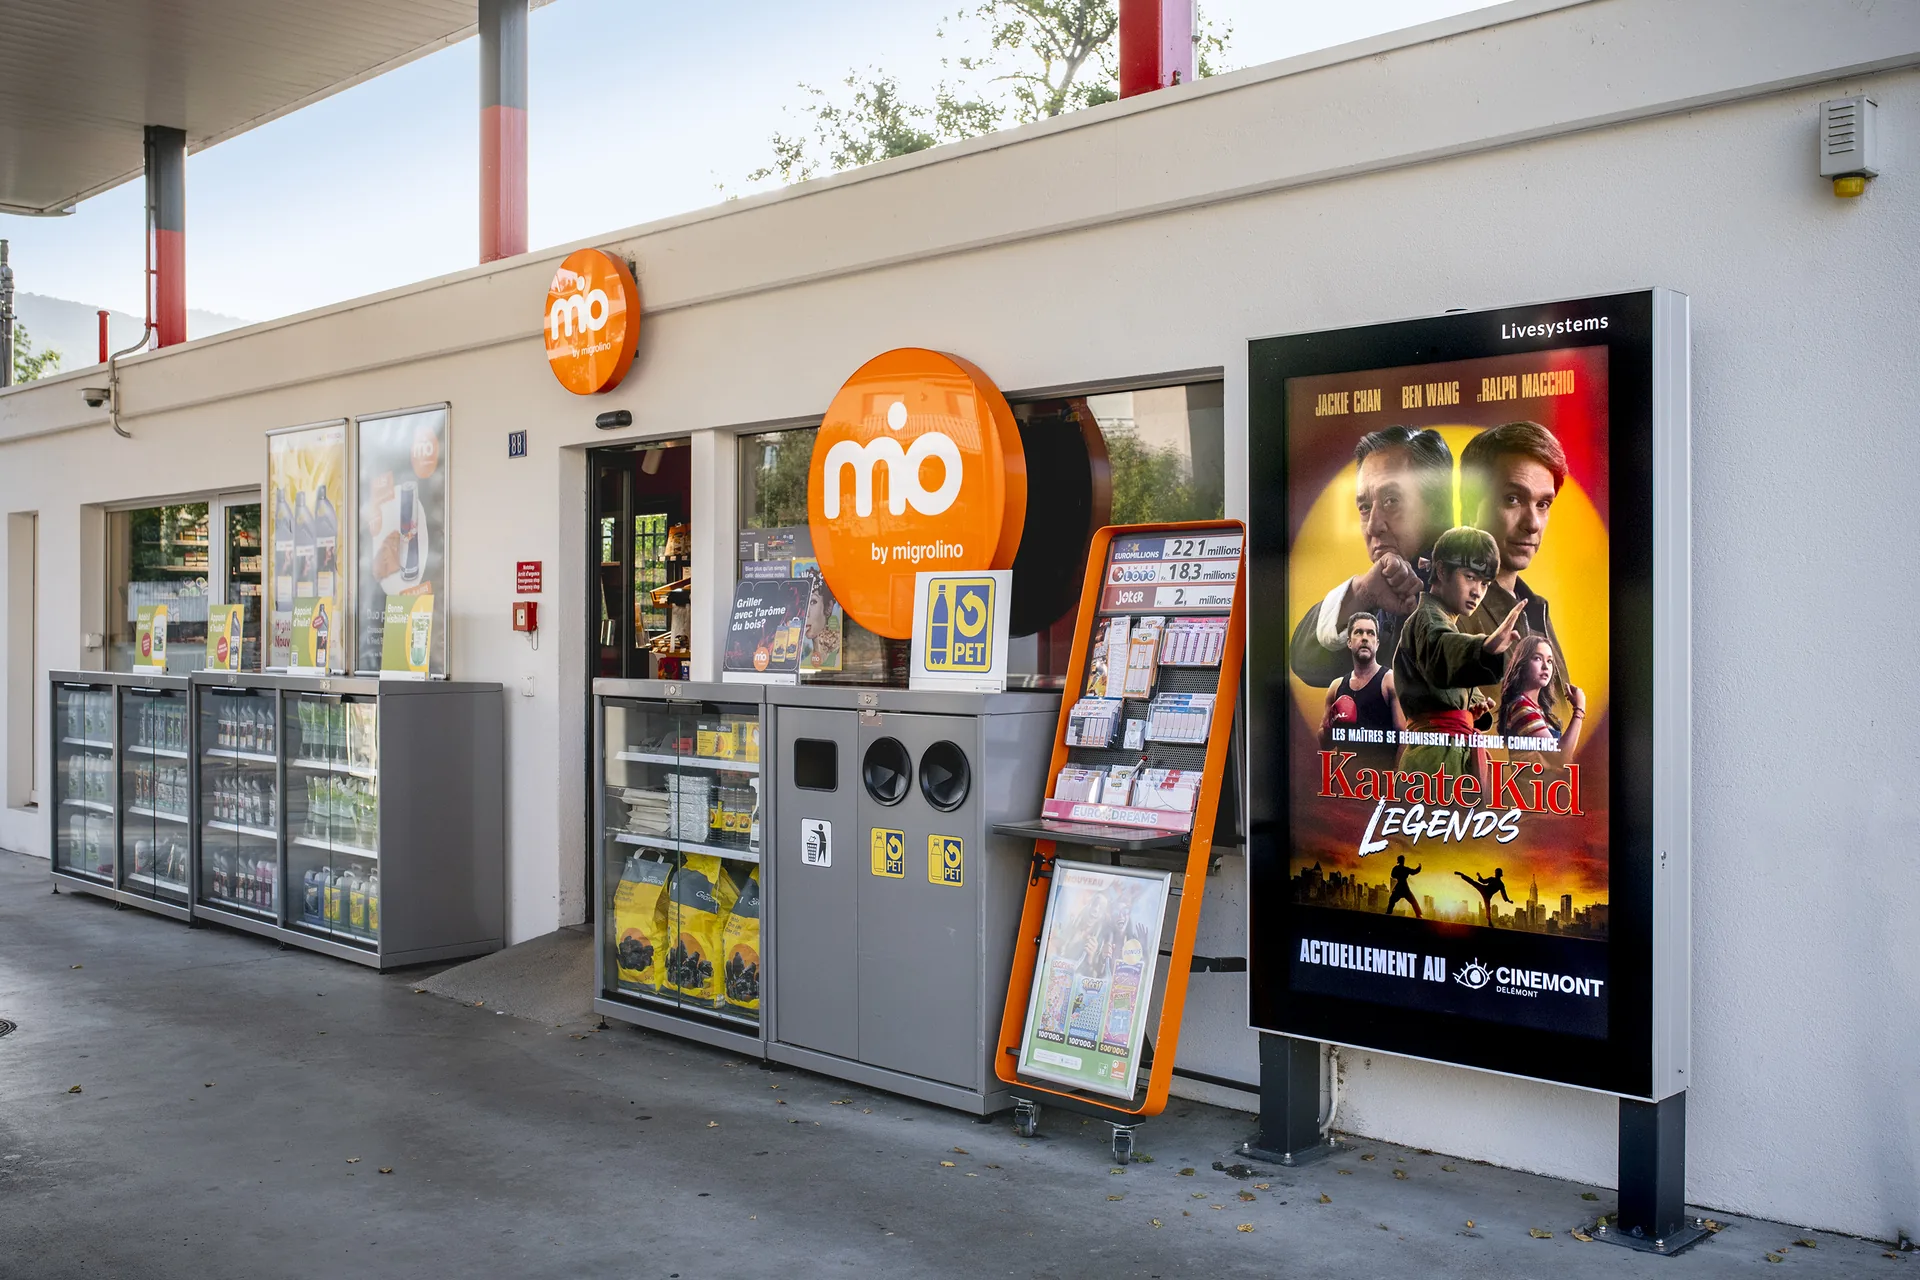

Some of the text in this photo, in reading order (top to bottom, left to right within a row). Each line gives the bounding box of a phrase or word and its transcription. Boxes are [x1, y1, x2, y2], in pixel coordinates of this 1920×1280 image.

[550, 275, 609, 341] mio
[1501, 315, 1609, 340] Livesystems
[572, 341, 611, 359] by migrolino
[1315, 391, 1350, 417] JACKIE
[1353, 388, 1382, 414] CHAN
[1402, 384, 1423, 410] BEN
[1426, 380, 1460, 408] WANG
[1482, 374, 1517, 402] RALPH
[1521, 369, 1575, 399] MACCHIO
[511, 433, 522, 455] 88
[823, 401, 964, 520] mio
[871, 539, 964, 565] by migrolino
[1114, 550, 1160, 560] EUROMILLIONS
[1207, 545, 1241, 556] millions
[1124, 570, 1156, 582] LOTO
[1203, 571, 1236, 581] millions
[736, 597, 763, 608] Griller
[1115, 590, 1144, 606] JOKER
[1198, 595, 1232, 605] millions
[734, 606, 786, 620] avec l'arôme
[732, 619, 766, 631] du bois?
[954, 642, 985, 663] PET
[1332, 726, 1562, 753] LES MAÎTRES SE RÉUNISSENT. LA LÉGENDE COMMENCE.
[1317, 749, 1585, 817] Karate Kid
[1111, 809, 1158, 825] DREAMS
[1358, 795, 1522, 857] LEGENDS
[887, 859, 902, 873] PET
[944, 867, 960, 881] PET
[1300, 938, 1604, 998] ACTUELLEMENT AU CINEMONT
[1496, 985, 1539, 999] DELÉMONT
